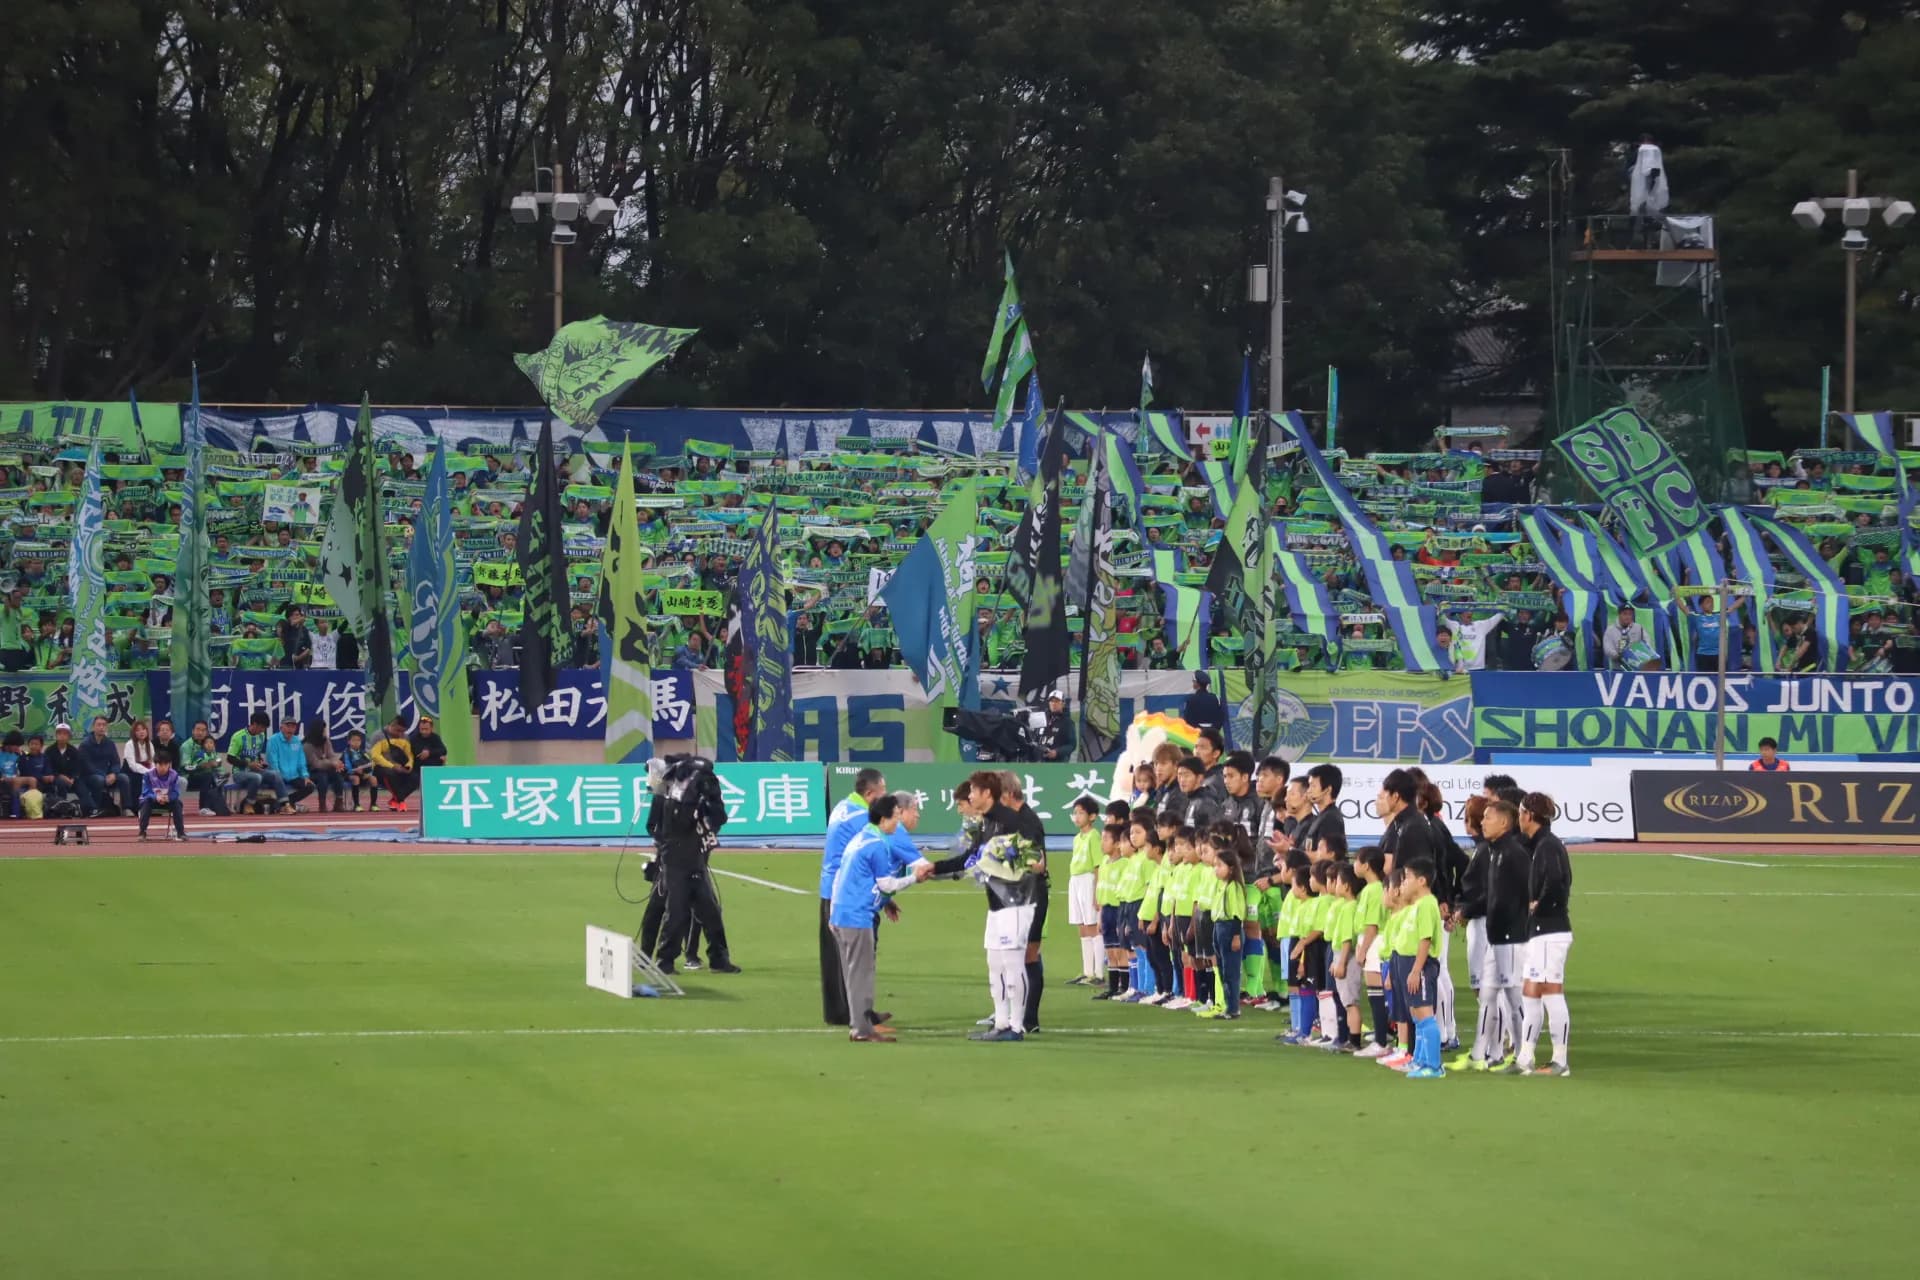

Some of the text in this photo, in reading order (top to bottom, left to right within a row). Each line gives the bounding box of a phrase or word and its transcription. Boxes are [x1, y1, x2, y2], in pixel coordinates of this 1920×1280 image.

[1767, 678, 1914, 714] JUNTO
[1481, 708, 1748, 751] SHONAN
[1778, 713, 1834, 752] MI
[1458, 777, 1481, 790] Life
[1689, 794, 1743, 807] RIZAP
